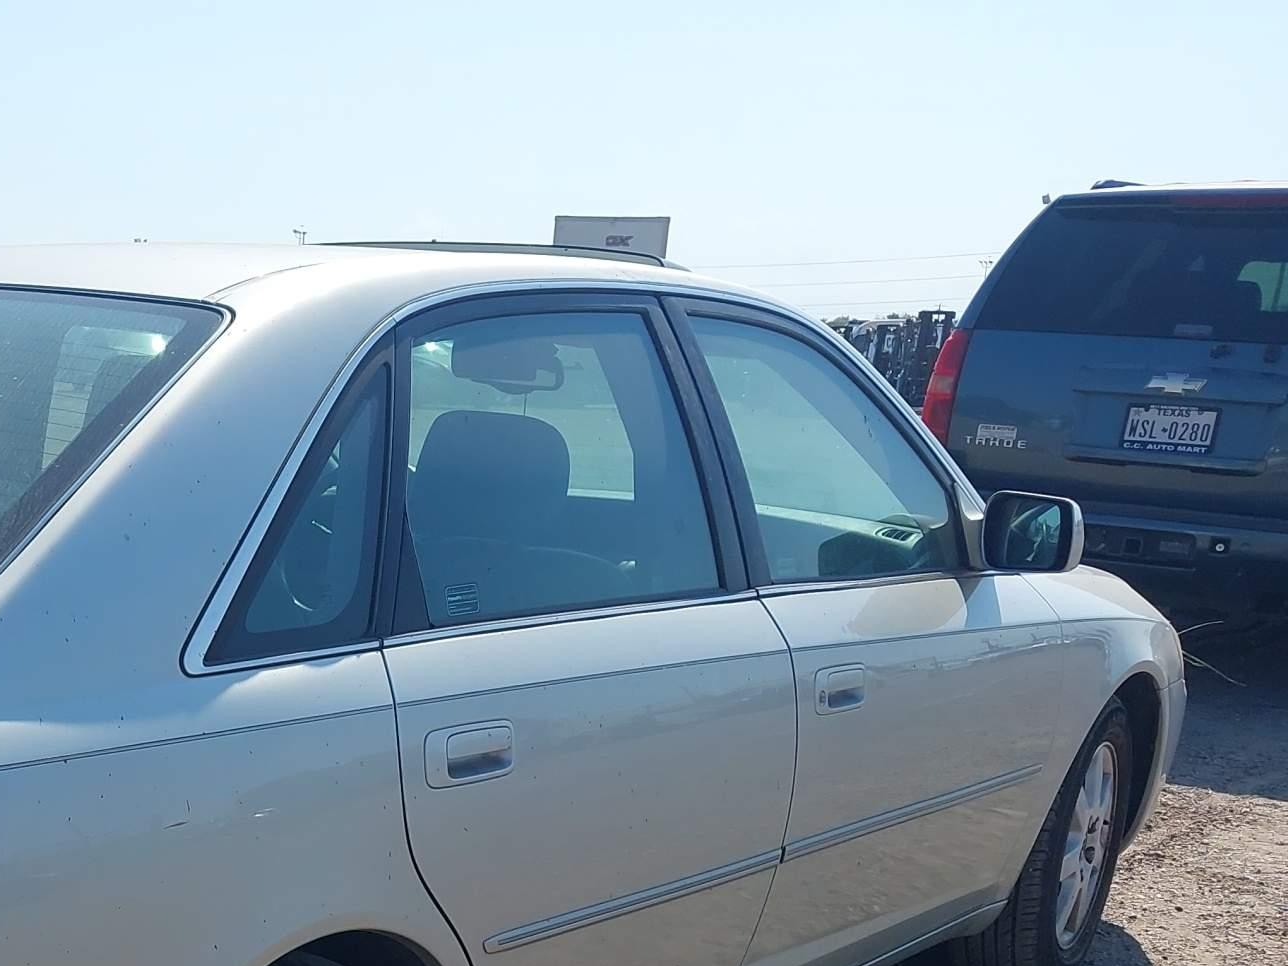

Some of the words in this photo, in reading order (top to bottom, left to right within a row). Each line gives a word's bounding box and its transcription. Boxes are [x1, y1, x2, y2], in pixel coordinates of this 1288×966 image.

[1156, 408, 1192, 418] TEXAS
[964, 435, 1029, 449] TAHOE
[1146, 444, 1175, 452] AUTO
[1176, 445, 1209, 454] MART
